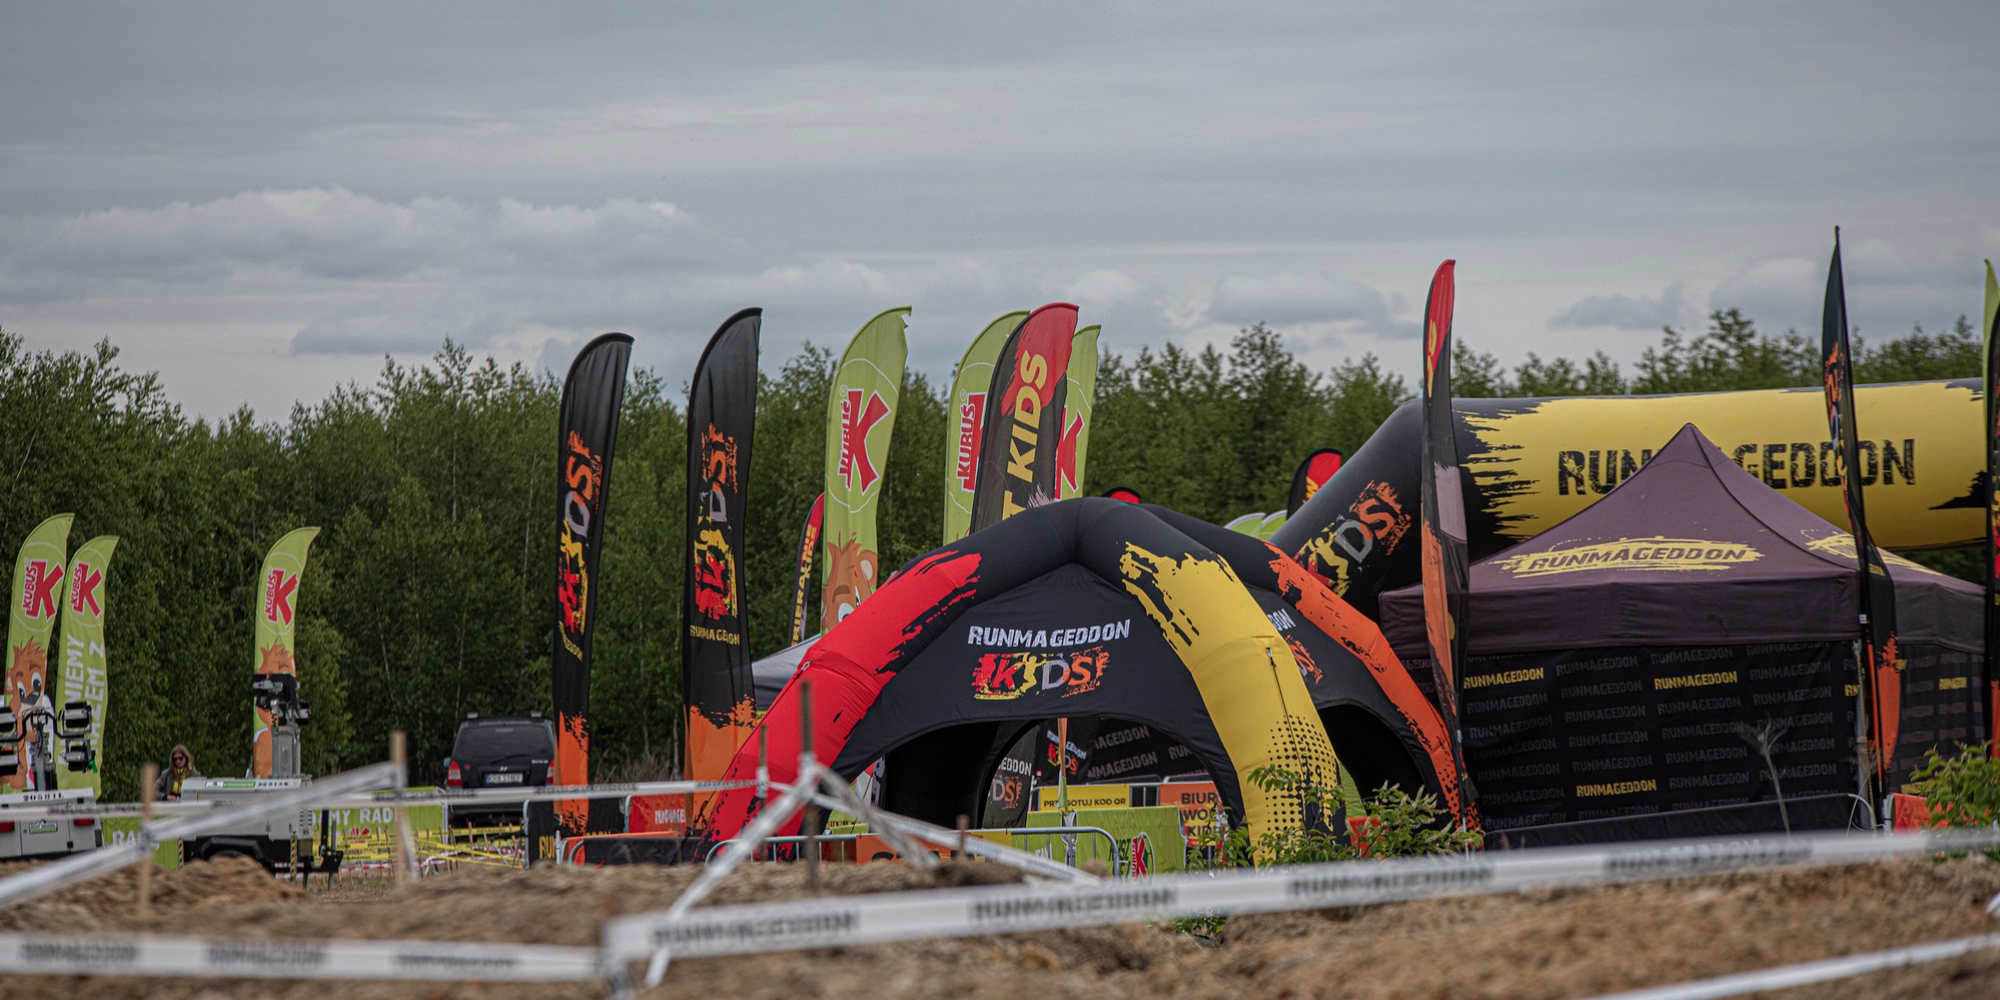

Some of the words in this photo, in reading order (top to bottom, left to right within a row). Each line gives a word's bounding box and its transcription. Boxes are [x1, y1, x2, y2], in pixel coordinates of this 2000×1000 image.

[1007, 350, 1047, 483] KIDS
[957, 401, 976, 479] KUBUŚ
[1528, 547, 1748, 571] RUNMAGEDDON
[968, 619, 1131, 648] RUNMAGEDDON
[89, 641, 104, 659] Z
[1651, 647, 1734, 665] RUNMAGEDDON
[972, 646, 1110, 699] KIDS
[1556, 656, 1638, 676] RUNMAGEDDON
[1750, 661, 1832, 681] RUNMAGEDDON
[1463, 667, 1545, 689] RUNMAGEDDON
[1654, 671, 1738, 690] RUNMAGEDDON
[1561, 680, 1643, 699] RUNMAGEDDON
[1753, 686, 1832, 706] RUNMAGEDDON
[1466, 693, 1548, 714] RUNMAGEDDON
[1657, 696, 1741, 715] RUNMAGEDDON
[1565, 705, 1646, 723] RUNMAGEDDON
[1568, 731, 1649, 748] RUNMAGEDDON
[1572, 755, 1653, 773] RUNMAGEDDON
[1666, 746, 1748, 764] RUNMAGEDDON
[1478, 763, 1560, 782] RUNMAGEDDON
[1669, 771, 1750, 790] RUNMAGEDDON
[1576, 779, 1657, 797] RUNMAGEDDON
[1094, 799, 1112, 807] KOD
[1114, 798, 1126, 806] QR
